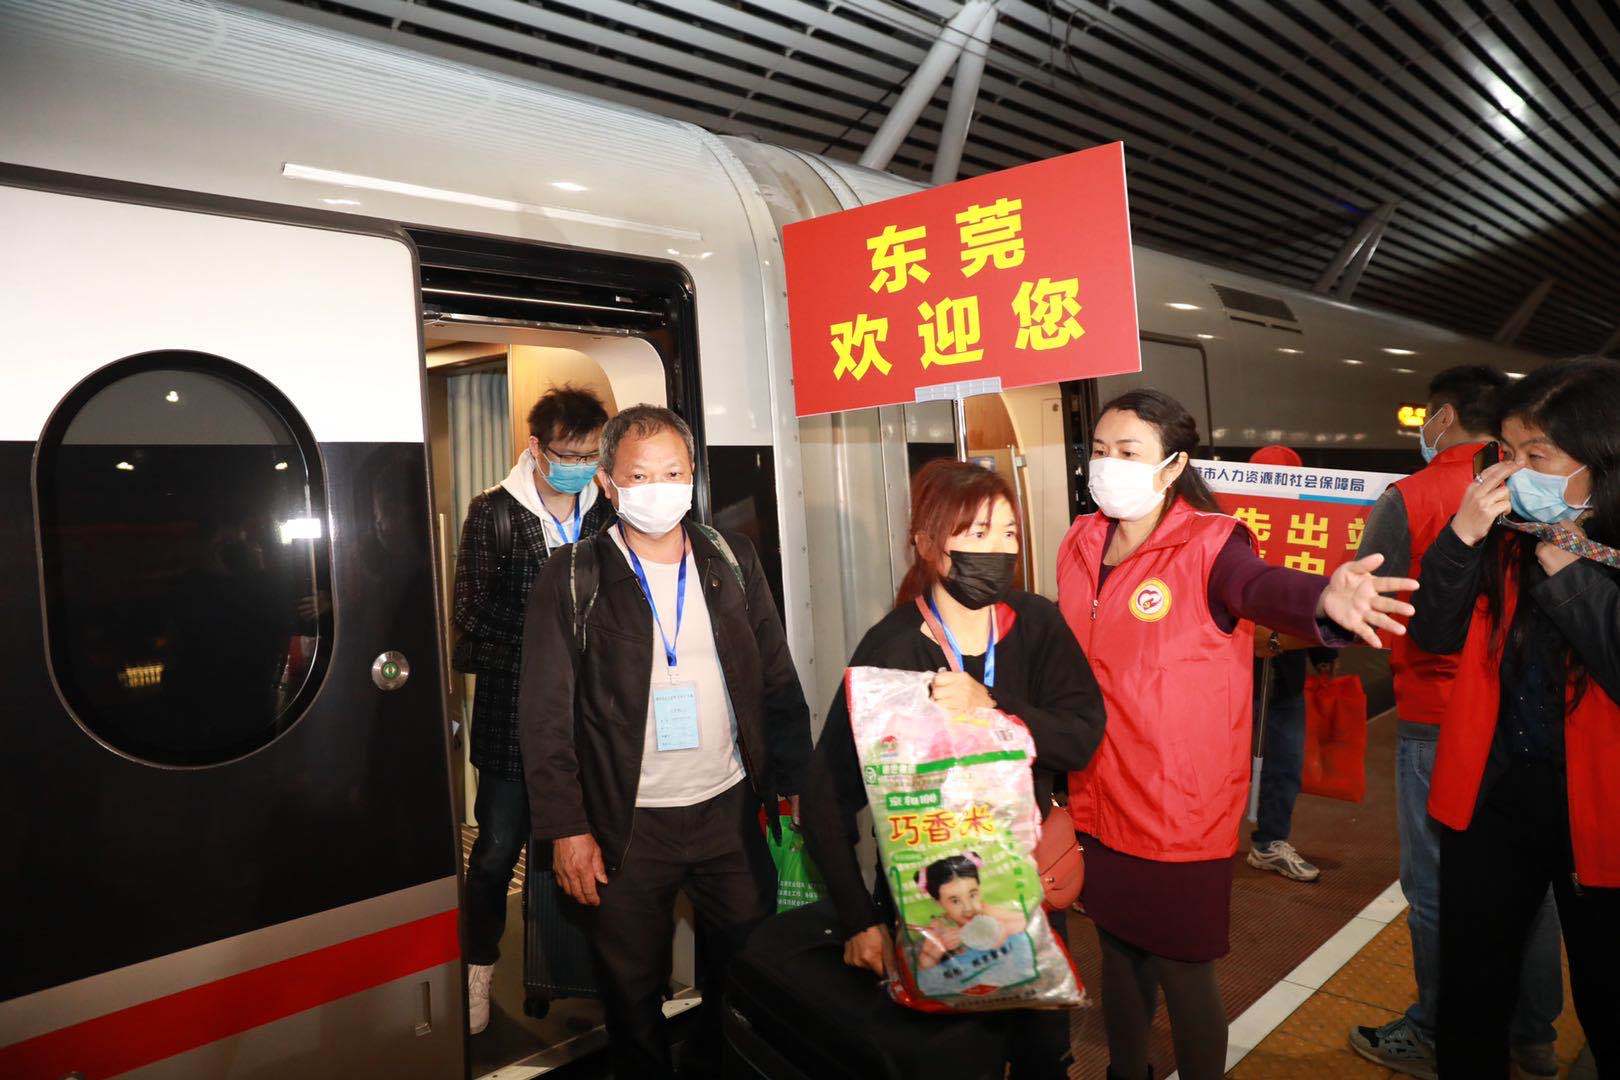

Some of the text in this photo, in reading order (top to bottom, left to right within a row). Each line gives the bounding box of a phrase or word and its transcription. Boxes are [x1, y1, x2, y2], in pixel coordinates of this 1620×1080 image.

[866, 197, 1026, 293] 东莞
[830, 277, 1086, 381] 欢迎您
[1196, 465, 1366, 493] 市人力资源和社会保障局
[888, 804, 995, 846] 巧香米
